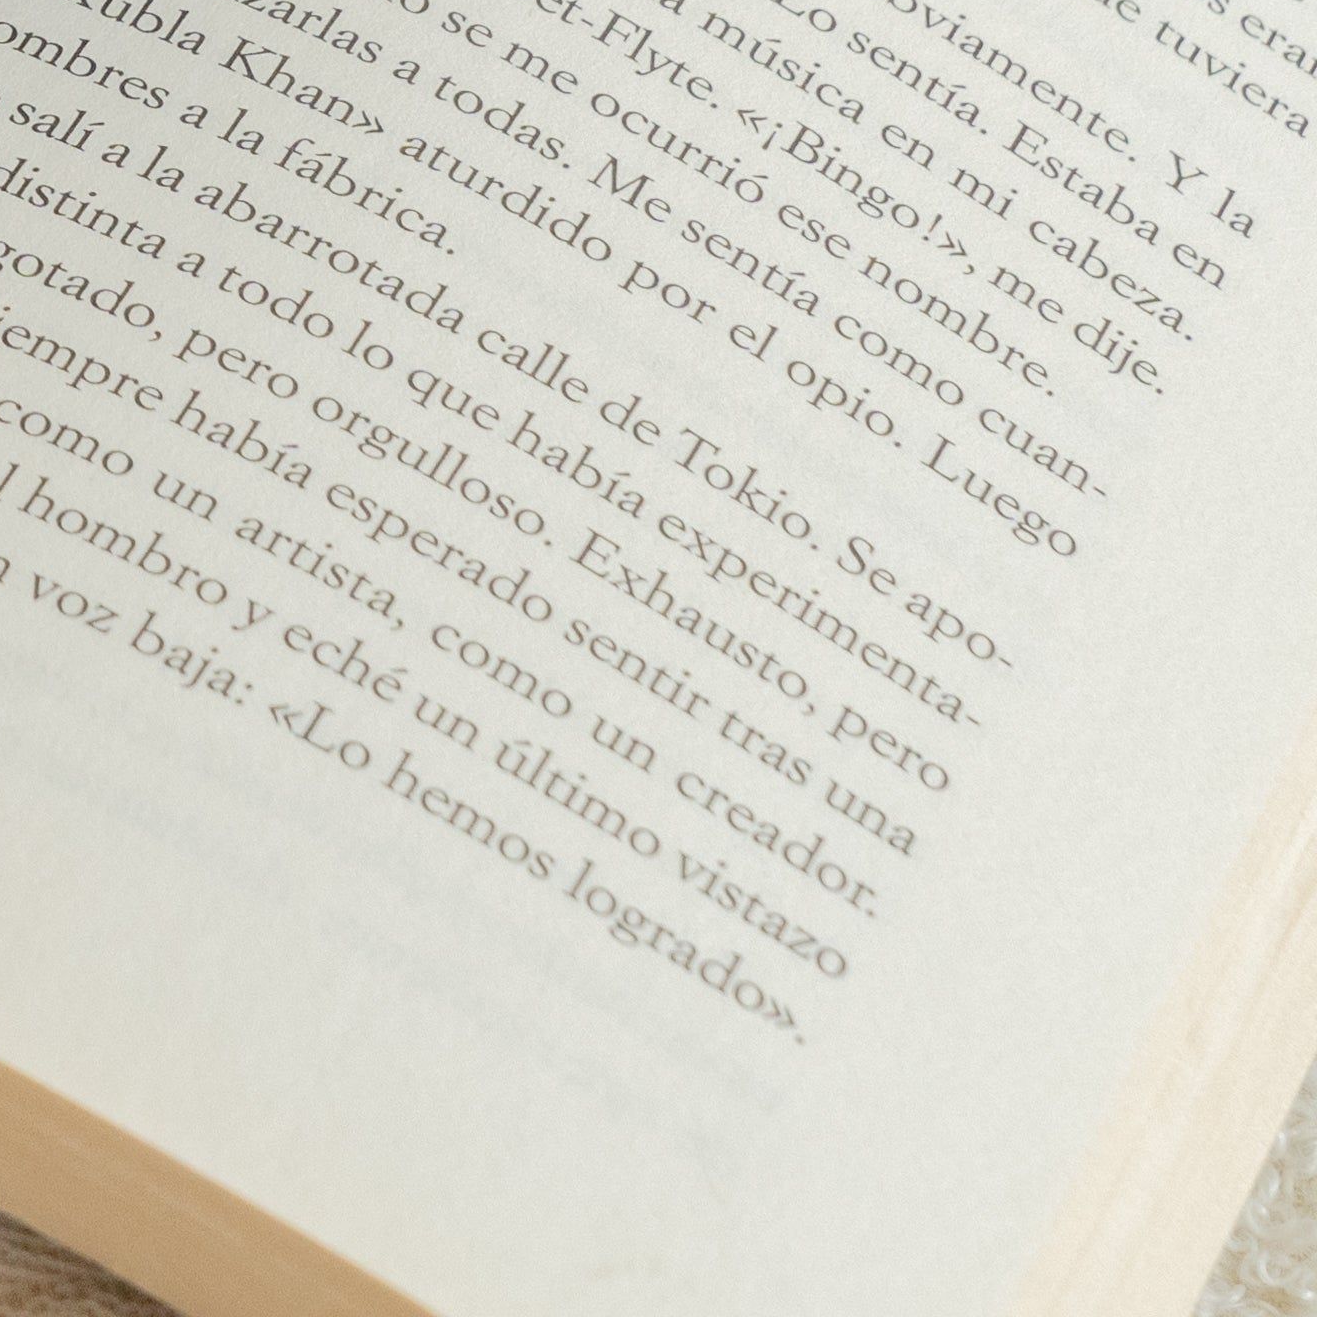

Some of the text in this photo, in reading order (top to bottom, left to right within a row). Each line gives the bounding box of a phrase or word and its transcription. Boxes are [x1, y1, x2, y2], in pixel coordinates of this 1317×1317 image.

[217, 34, 386, 136] Khan»
[397, 136, 614, 263] aturdido
[617, 259, 718, 325] por
[727, 323, 780, 363] el
[785, 359, 903, 450] opio.
[920, 432, 1079, 558] Luego
[735, 107, 977, 277] «¡Bingo!»,
[987, 265, 1065, 326] me
[1072, 316, 1165, 397] dije.
[1165, 149, 1209, 196] Y
[1211, 186, 1256, 240] la
[31, 572, 120, 636] voz
[128, 609, 254, 707] baja:
[267, 701, 373, 770] «Lo
[382, 748, 557, 881] hemos
[563, 857, 807, 1047] logrado».
